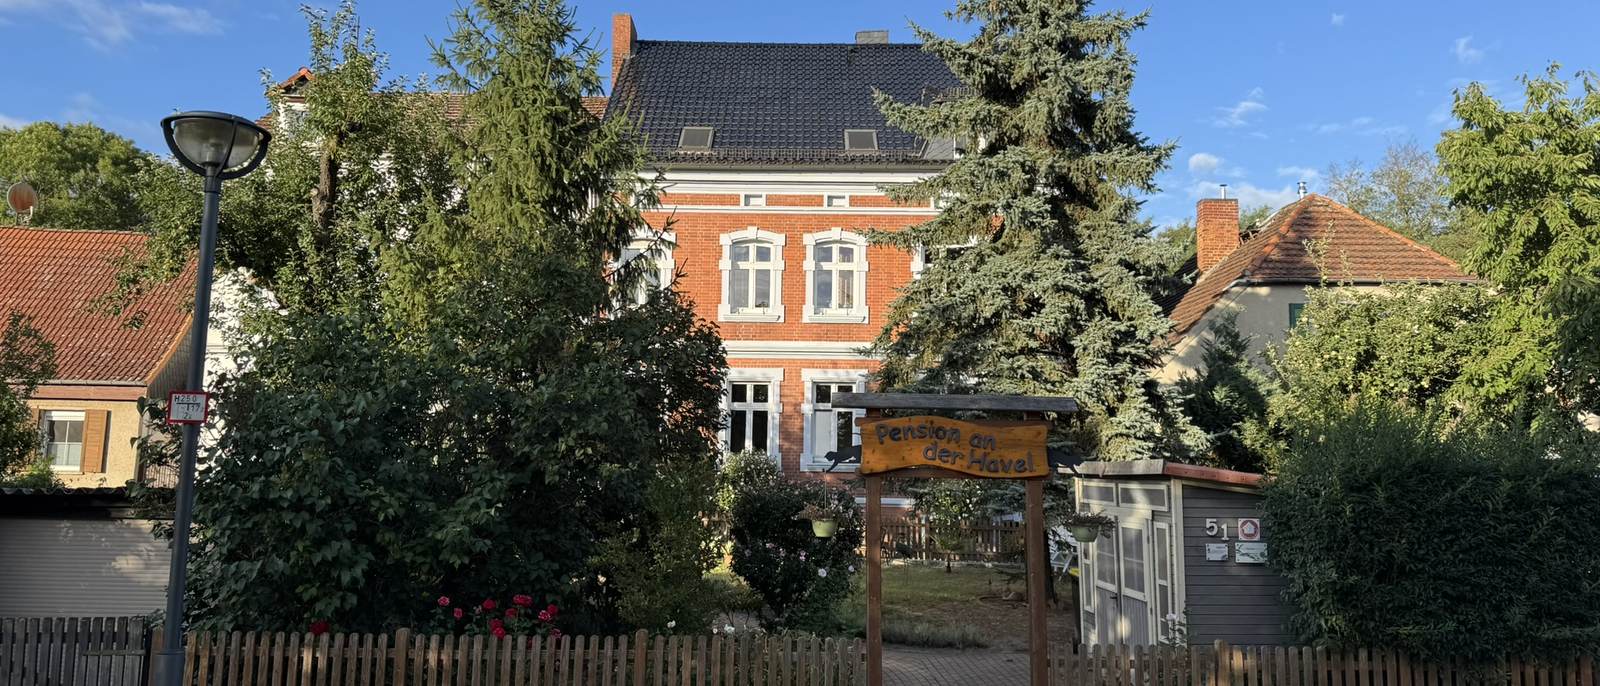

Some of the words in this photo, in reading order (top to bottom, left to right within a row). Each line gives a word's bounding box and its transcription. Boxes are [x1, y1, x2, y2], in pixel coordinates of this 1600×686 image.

[877, 423, 961, 445] Pension
[970, 433, 996, 450] an
[924, 443, 964, 465] der
[968, 450, 1036, 473] Havel
[1206, 518, 1229, 540] 51
